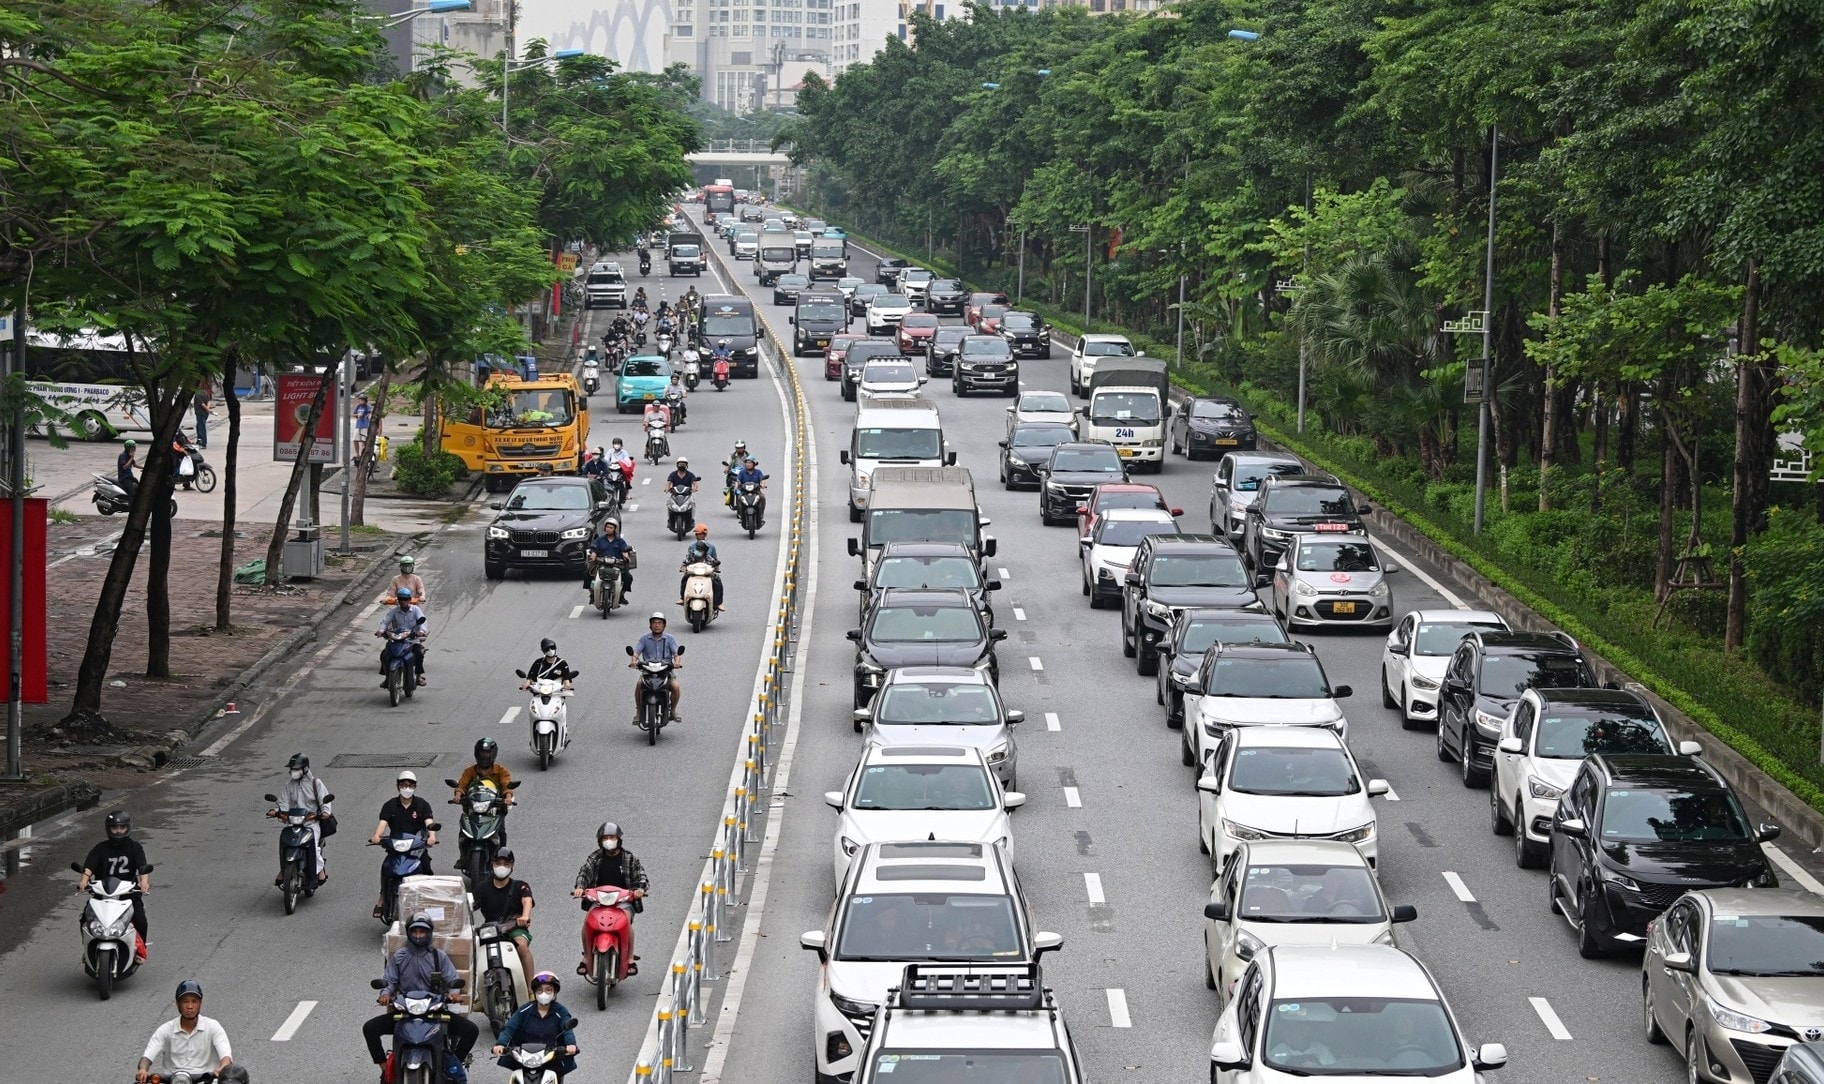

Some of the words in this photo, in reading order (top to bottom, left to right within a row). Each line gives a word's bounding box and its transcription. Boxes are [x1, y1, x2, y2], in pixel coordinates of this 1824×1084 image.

[83, 387, 109, 396] PHARBACO
[283, 392, 308, 400] LIGHT
[1115, 428, 1134, 438] 24h
[108, 855, 130, 875] 72
